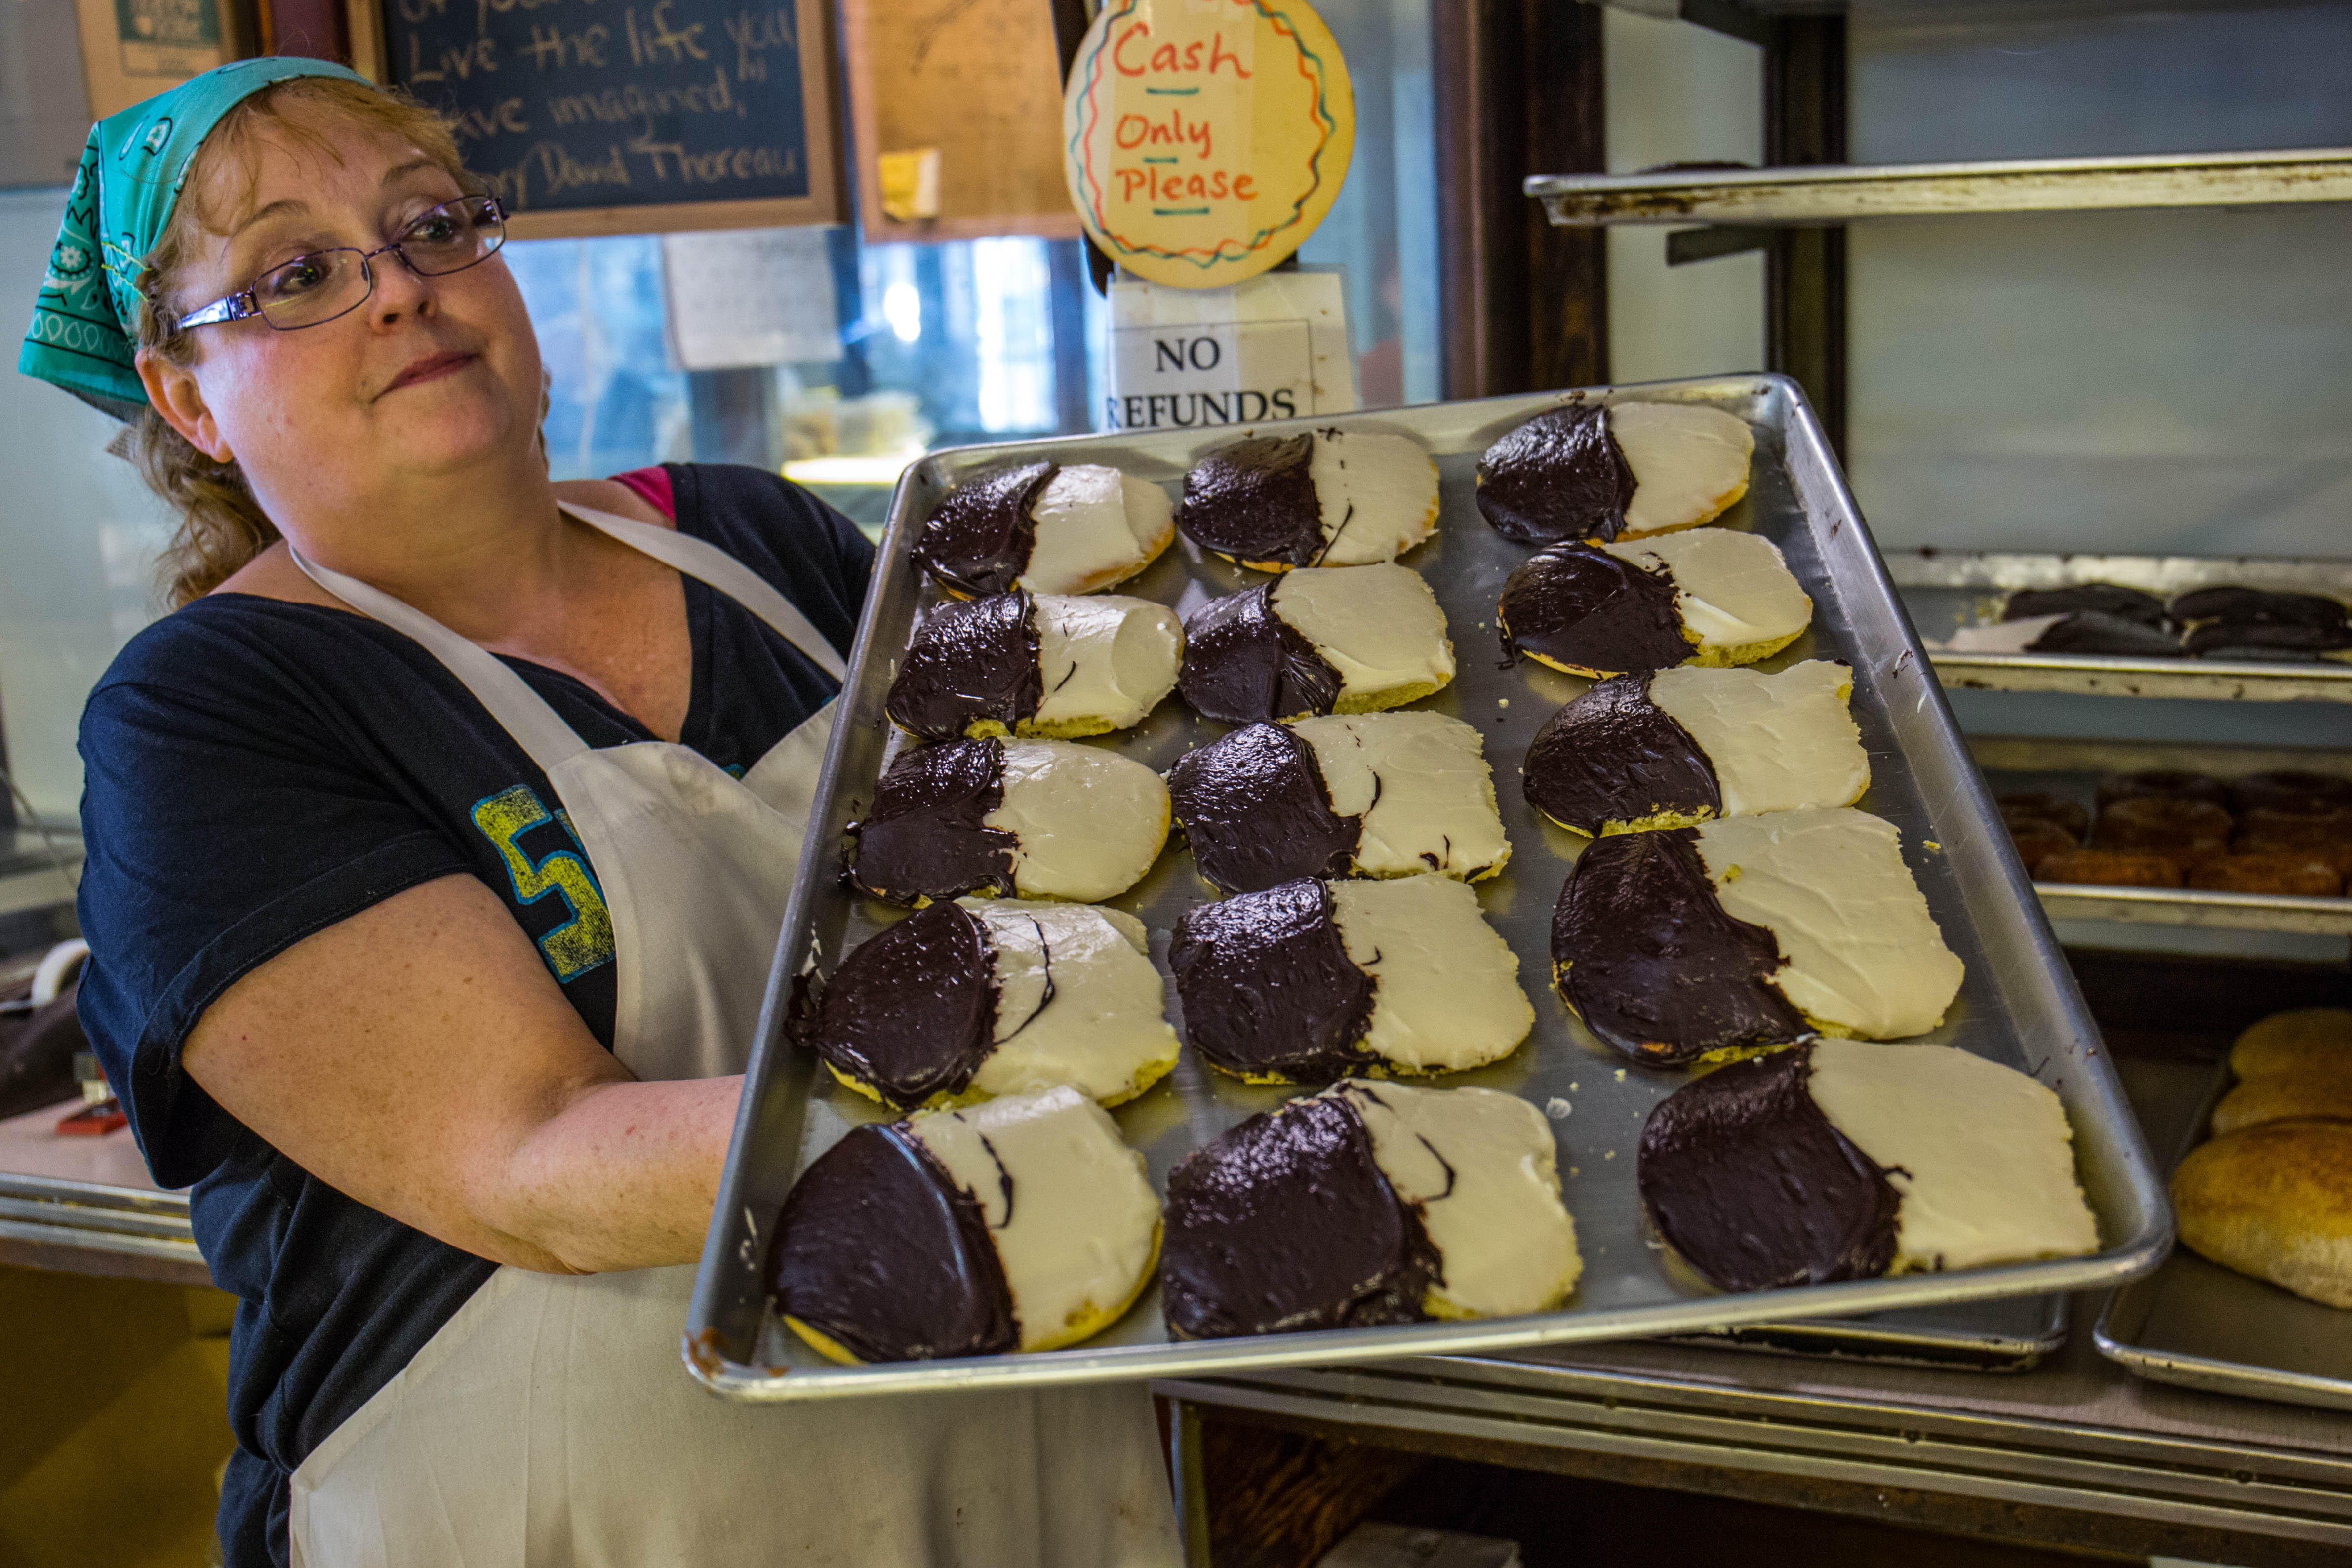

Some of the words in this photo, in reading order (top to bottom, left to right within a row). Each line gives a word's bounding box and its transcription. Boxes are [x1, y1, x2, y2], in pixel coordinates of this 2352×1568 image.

[409, 32, 498, 84] Live
[517, 23, 610, 70] the
[625, 0, 709, 66] life
[1112, 21, 1253, 78] Cash
[1115, 109, 1213, 160] Only
[1115, 166, 1259, 203] Please
[1155, 336, 1221, 372] NO
[1106, 388, 1296, 429] REFUNDS
